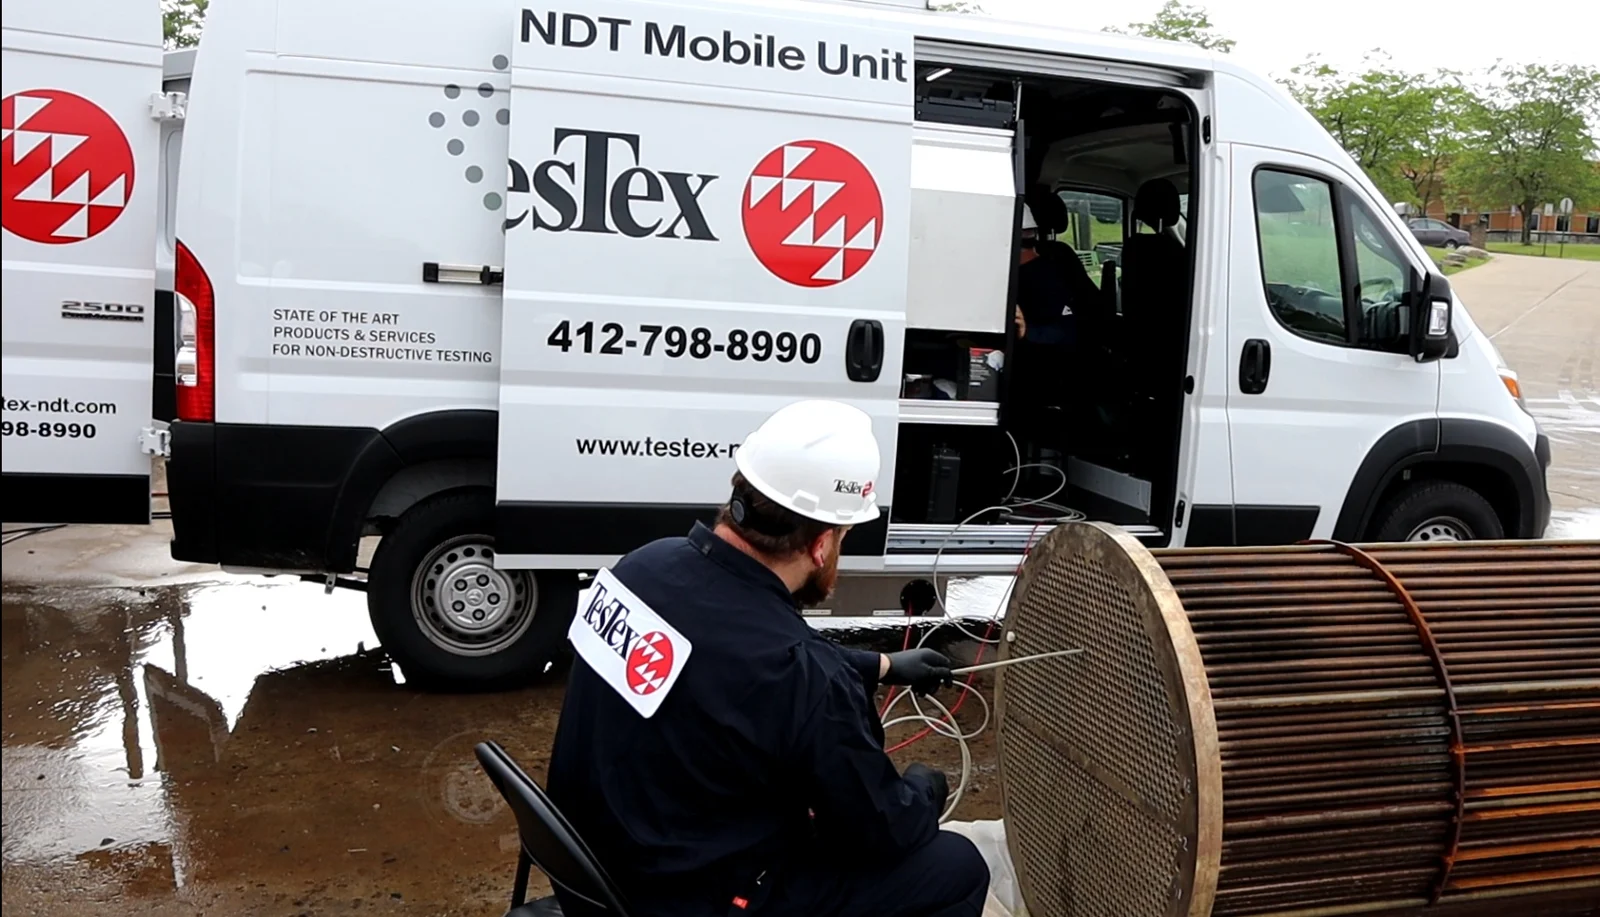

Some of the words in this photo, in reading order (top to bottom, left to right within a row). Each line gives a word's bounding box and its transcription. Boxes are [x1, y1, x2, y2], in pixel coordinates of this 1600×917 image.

[520, 8, 631, 51] NDT
[644, 22, 806, 71] Mobile
[817, 41, 908, 83] Unit
[505, 127, 720, 242] esTex
[61, 301, 144, 314] 2500
[273, 308, 315, 322] STATE
[319, 310, 338, 323] OF
[342, 311, 368, 324] THE
[371, 313, 400, 325] ART
[273, 326, 350, 340] PRODUCTS
[354, 329, 365, 341] &
[369, 330, 436, 344] SERVICES
[547, 320, 822, 364] 412-798-8990
[272, 343, 301, 356] FOR
[305, 345, 433, 361] NON-DESTRUCTIVE
[437, 350, 493, 363] TESTING
[2, 421, 96, 438] 98-8990
[582, 581, 640, 661] TesTex
